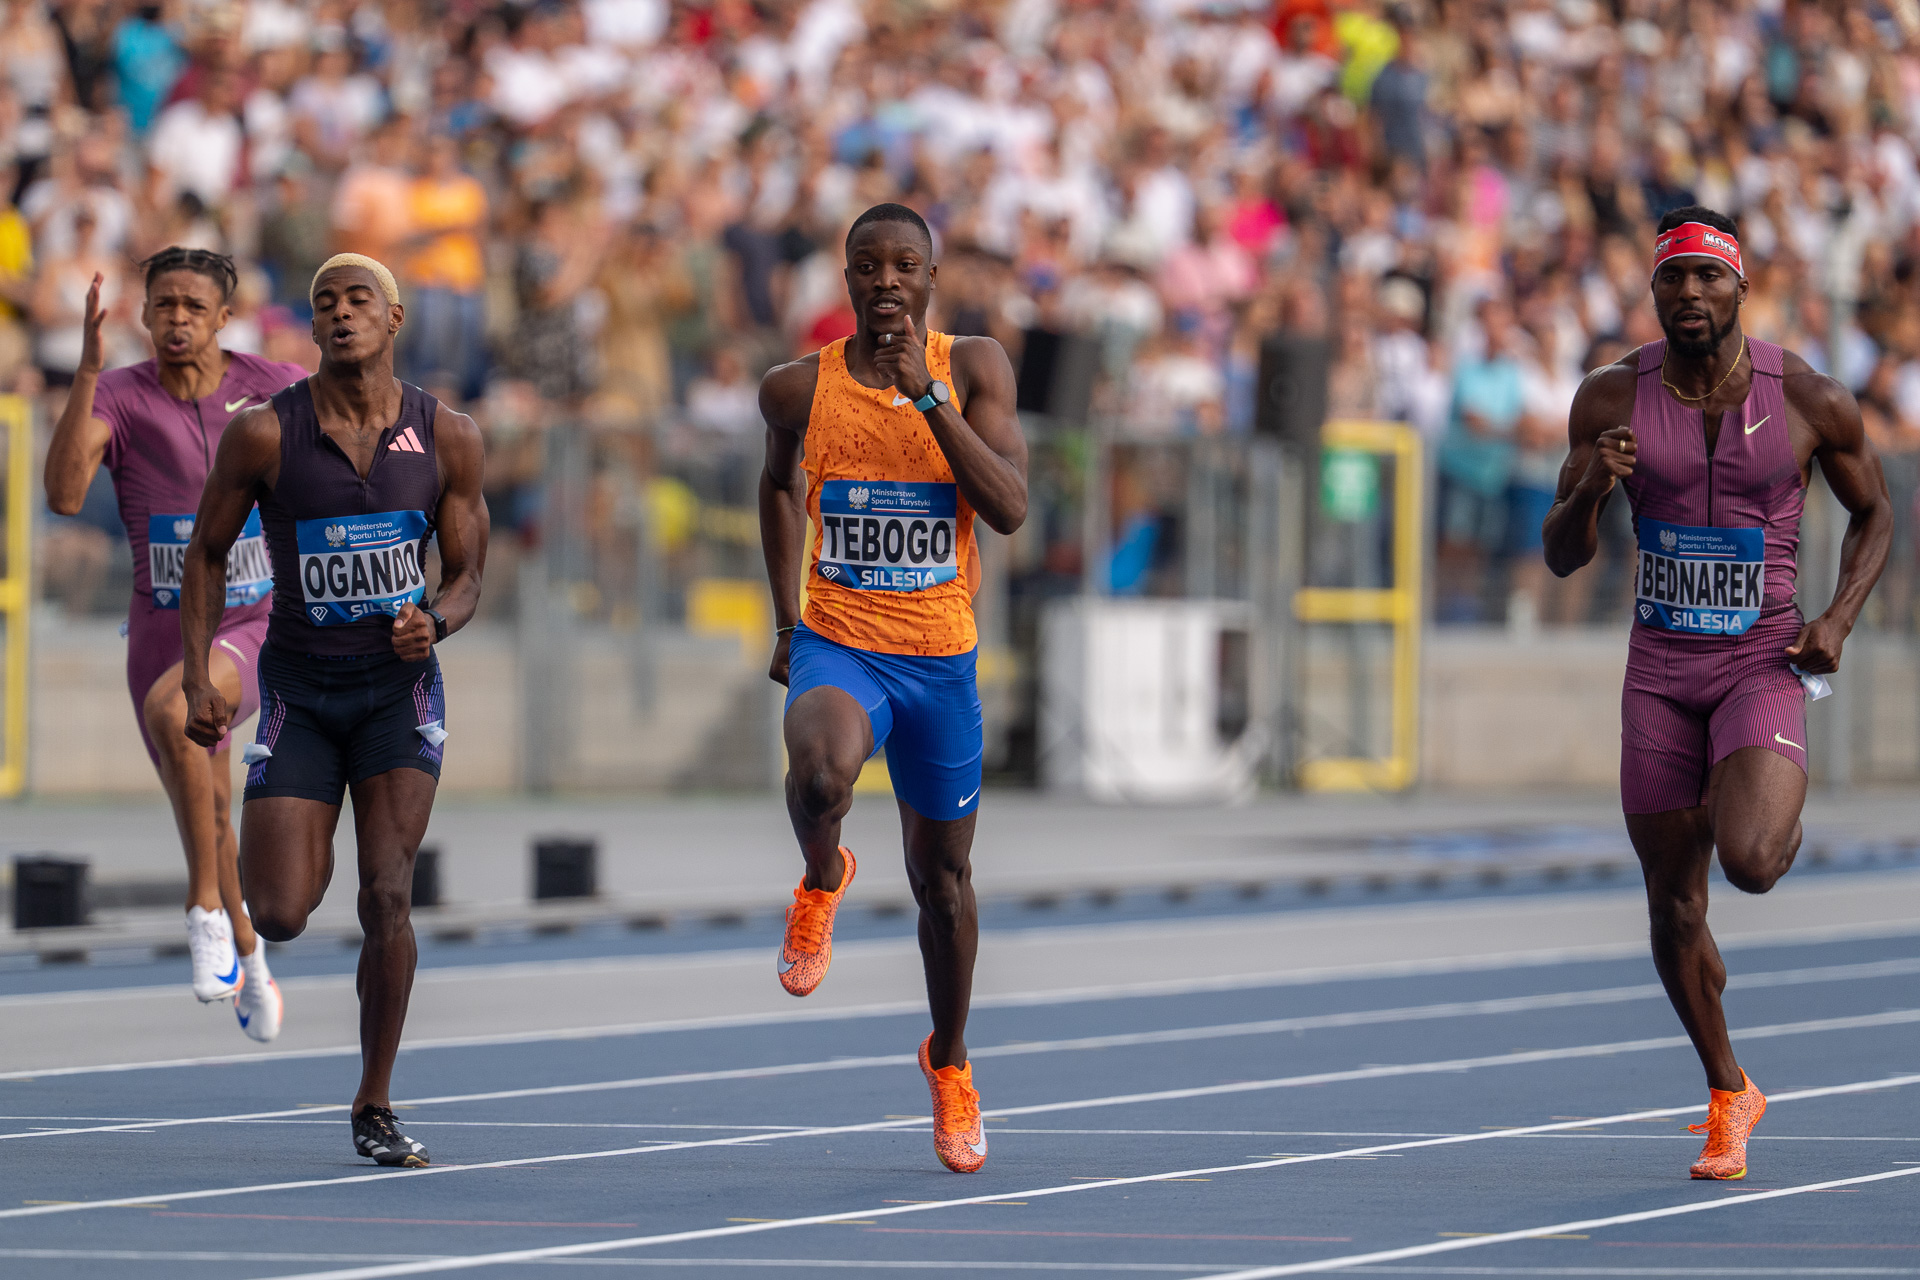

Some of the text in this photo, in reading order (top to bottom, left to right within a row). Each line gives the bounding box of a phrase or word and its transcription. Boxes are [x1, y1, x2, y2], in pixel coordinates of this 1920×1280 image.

[871, 488, 916, 498] Ministerstwo
[871, 497, 894, 506] Sportu
[899, 498, 931, 507] Turystyki
[347, 521, 393, 532] Ministerstwo
[348, 531, 372, 541] Sportu
[824, 515, 952, 564] TEBOGO
[1678, 533, 1723, 542] Ministerstwo
[1678, 541, 1701, 550] Sportu
[1706, 543, 1737, 551] Turystyki
[305, 542, 420, 598] OGANDO
[861, 570, 938, 587] SILESIA
[1641, 552, 1762, 608] BEDNAREK
[1672, 610, 1743, 630] SILESIA
